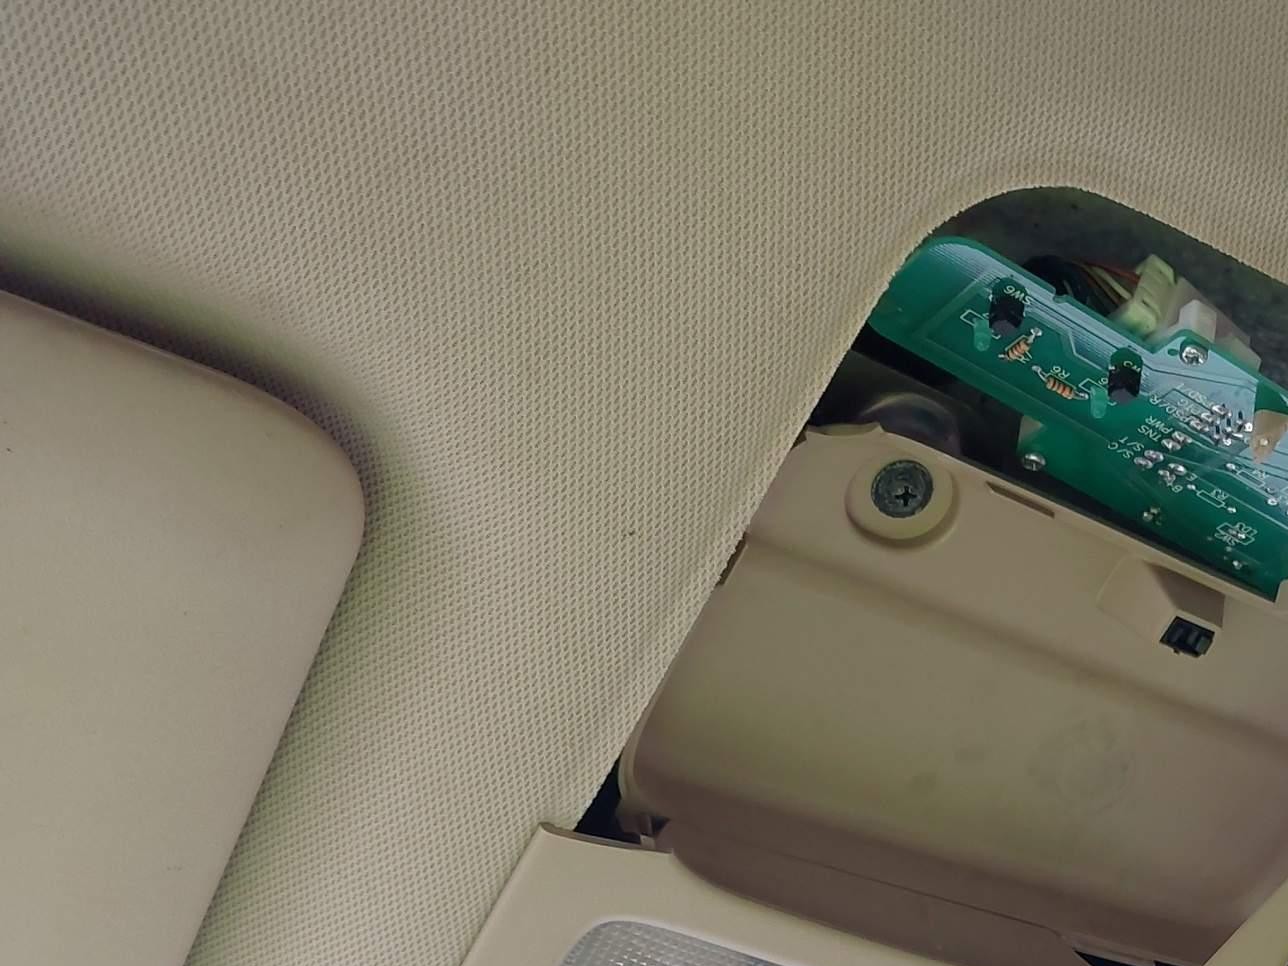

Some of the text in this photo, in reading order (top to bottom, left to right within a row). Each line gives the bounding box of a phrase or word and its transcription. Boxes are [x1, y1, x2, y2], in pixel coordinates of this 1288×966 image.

[1003, 285, 1033, 306] SW6
[1050, 365, 1071, 379] R6
[1144, 415, 1174, 435] PWR
[1107, 442, 1135, 459] S/C
[1118, 436, 1145, 451] S/T
